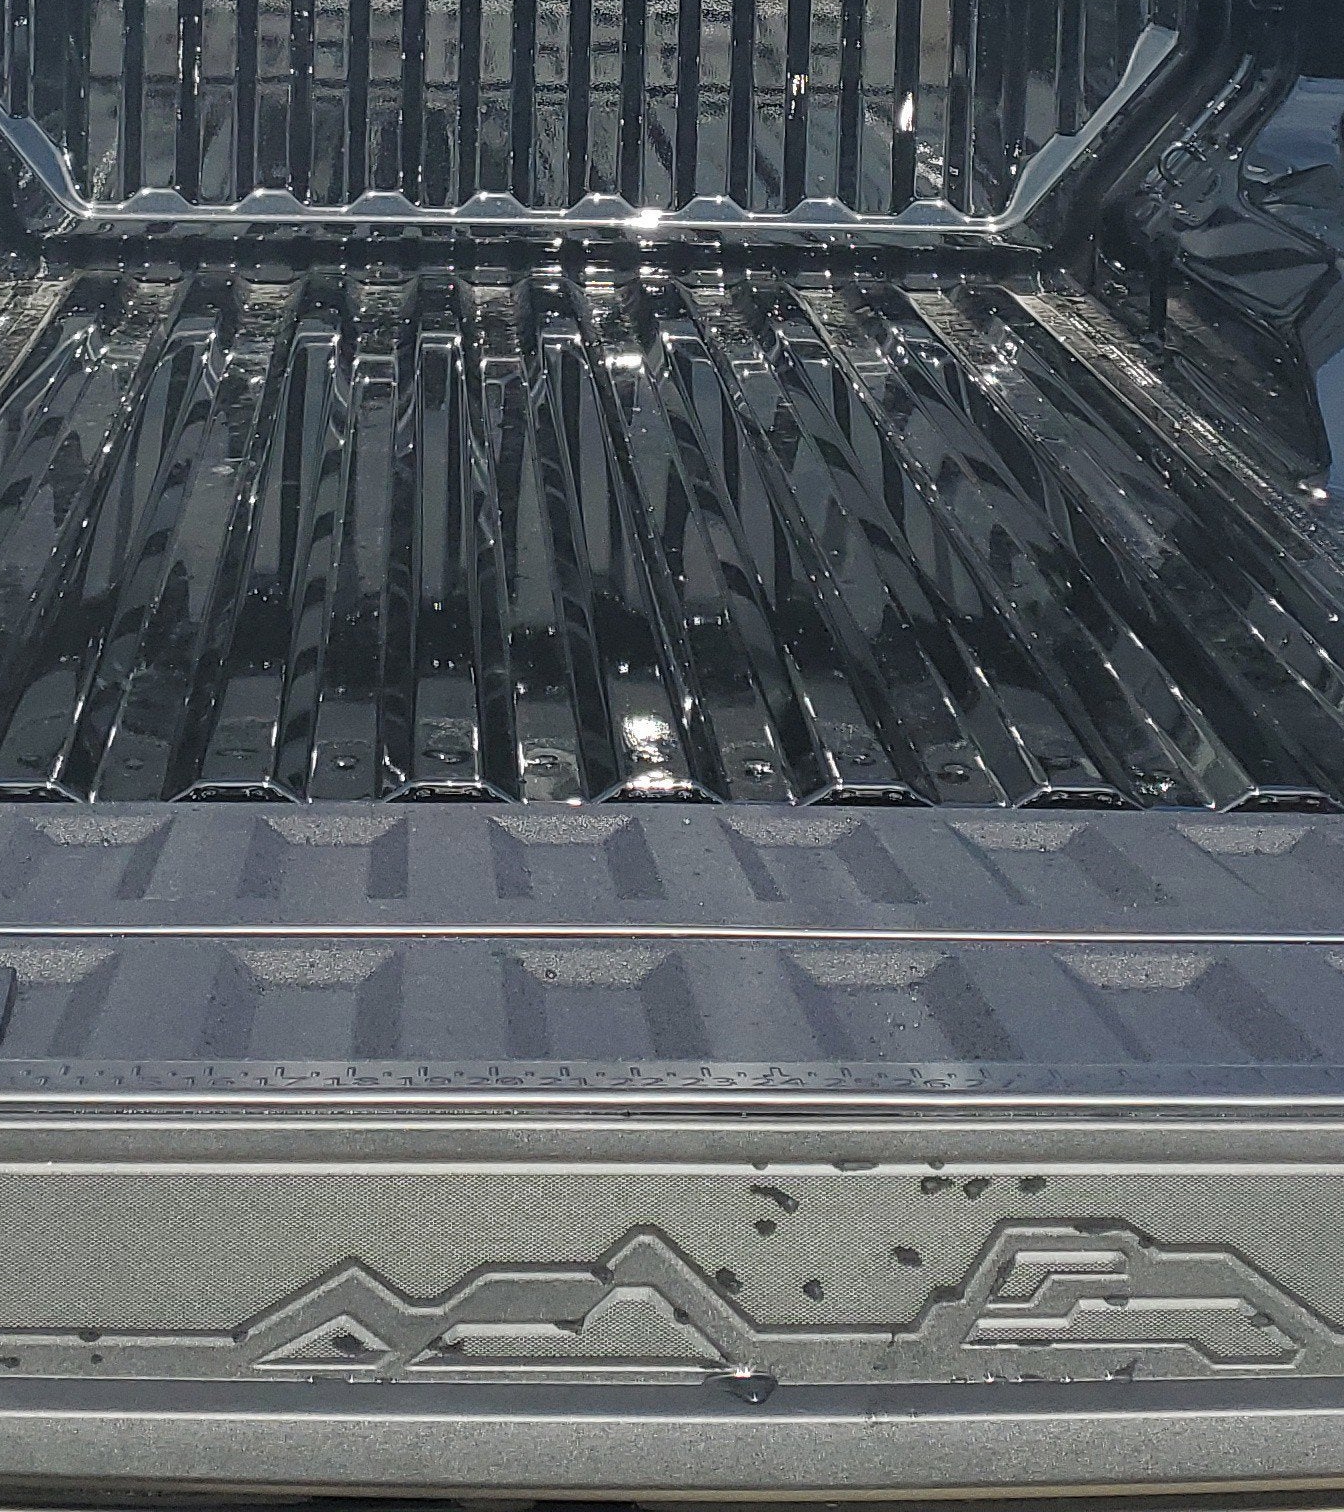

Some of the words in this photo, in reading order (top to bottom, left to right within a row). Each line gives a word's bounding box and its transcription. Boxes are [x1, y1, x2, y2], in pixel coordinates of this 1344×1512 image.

[253, 1076, 305, 1086] 17
[324, 1076, 379, 1086] 18
[397, 1076, 451, 1086] 19
[465, 1076, 522, 1086] 20
[536, 1076, 587, 1086] 21
[607, 1076, 668, 1086] 22
[678, 1076, 738, 1086] 23
[894, 1078, 949, 1088] 26
